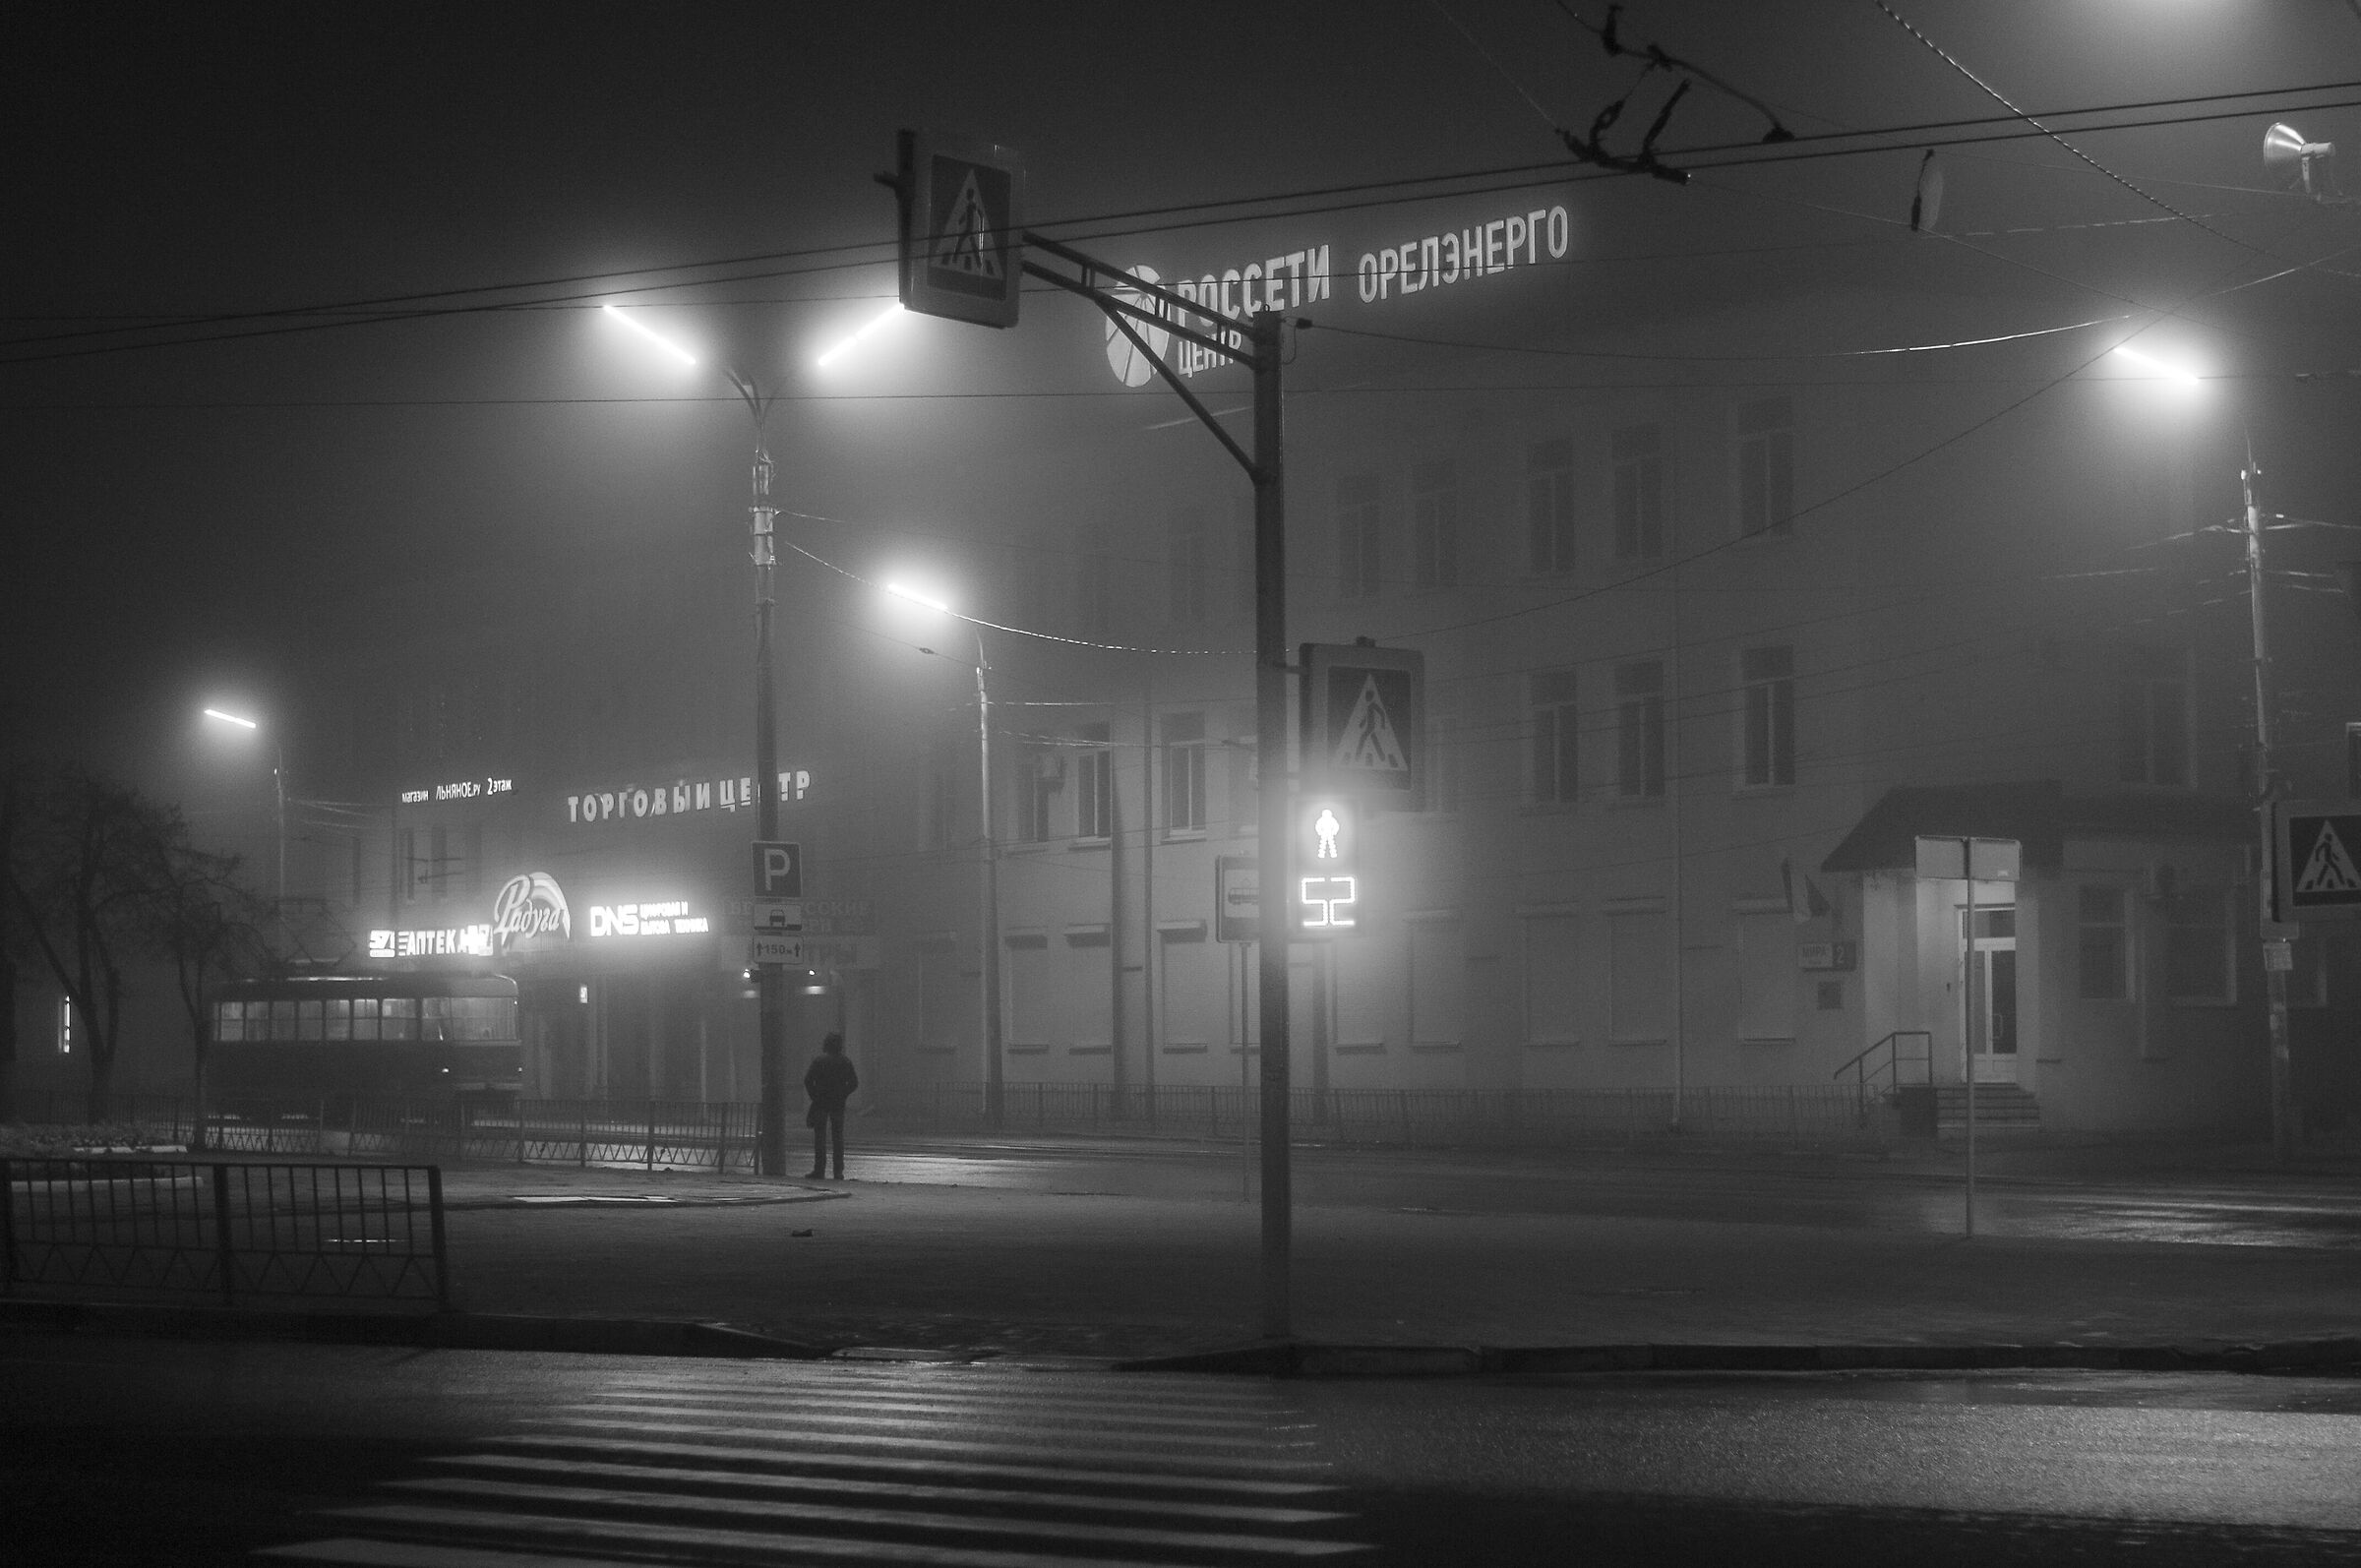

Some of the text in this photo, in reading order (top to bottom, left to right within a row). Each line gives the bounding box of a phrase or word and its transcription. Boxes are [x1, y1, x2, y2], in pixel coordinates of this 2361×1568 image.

[1177, 205, 1569, 329] РОССЕТИ ОРЕЛЭНЕРГО
[719, 770, 811, 813] ЦЕТР
[764, 849, 791, 891] P
[493, 874, 560, 945] Радуга
[590, 903, 639, 936] DNS
[406, 929, 468, 955] АПТЕКА
